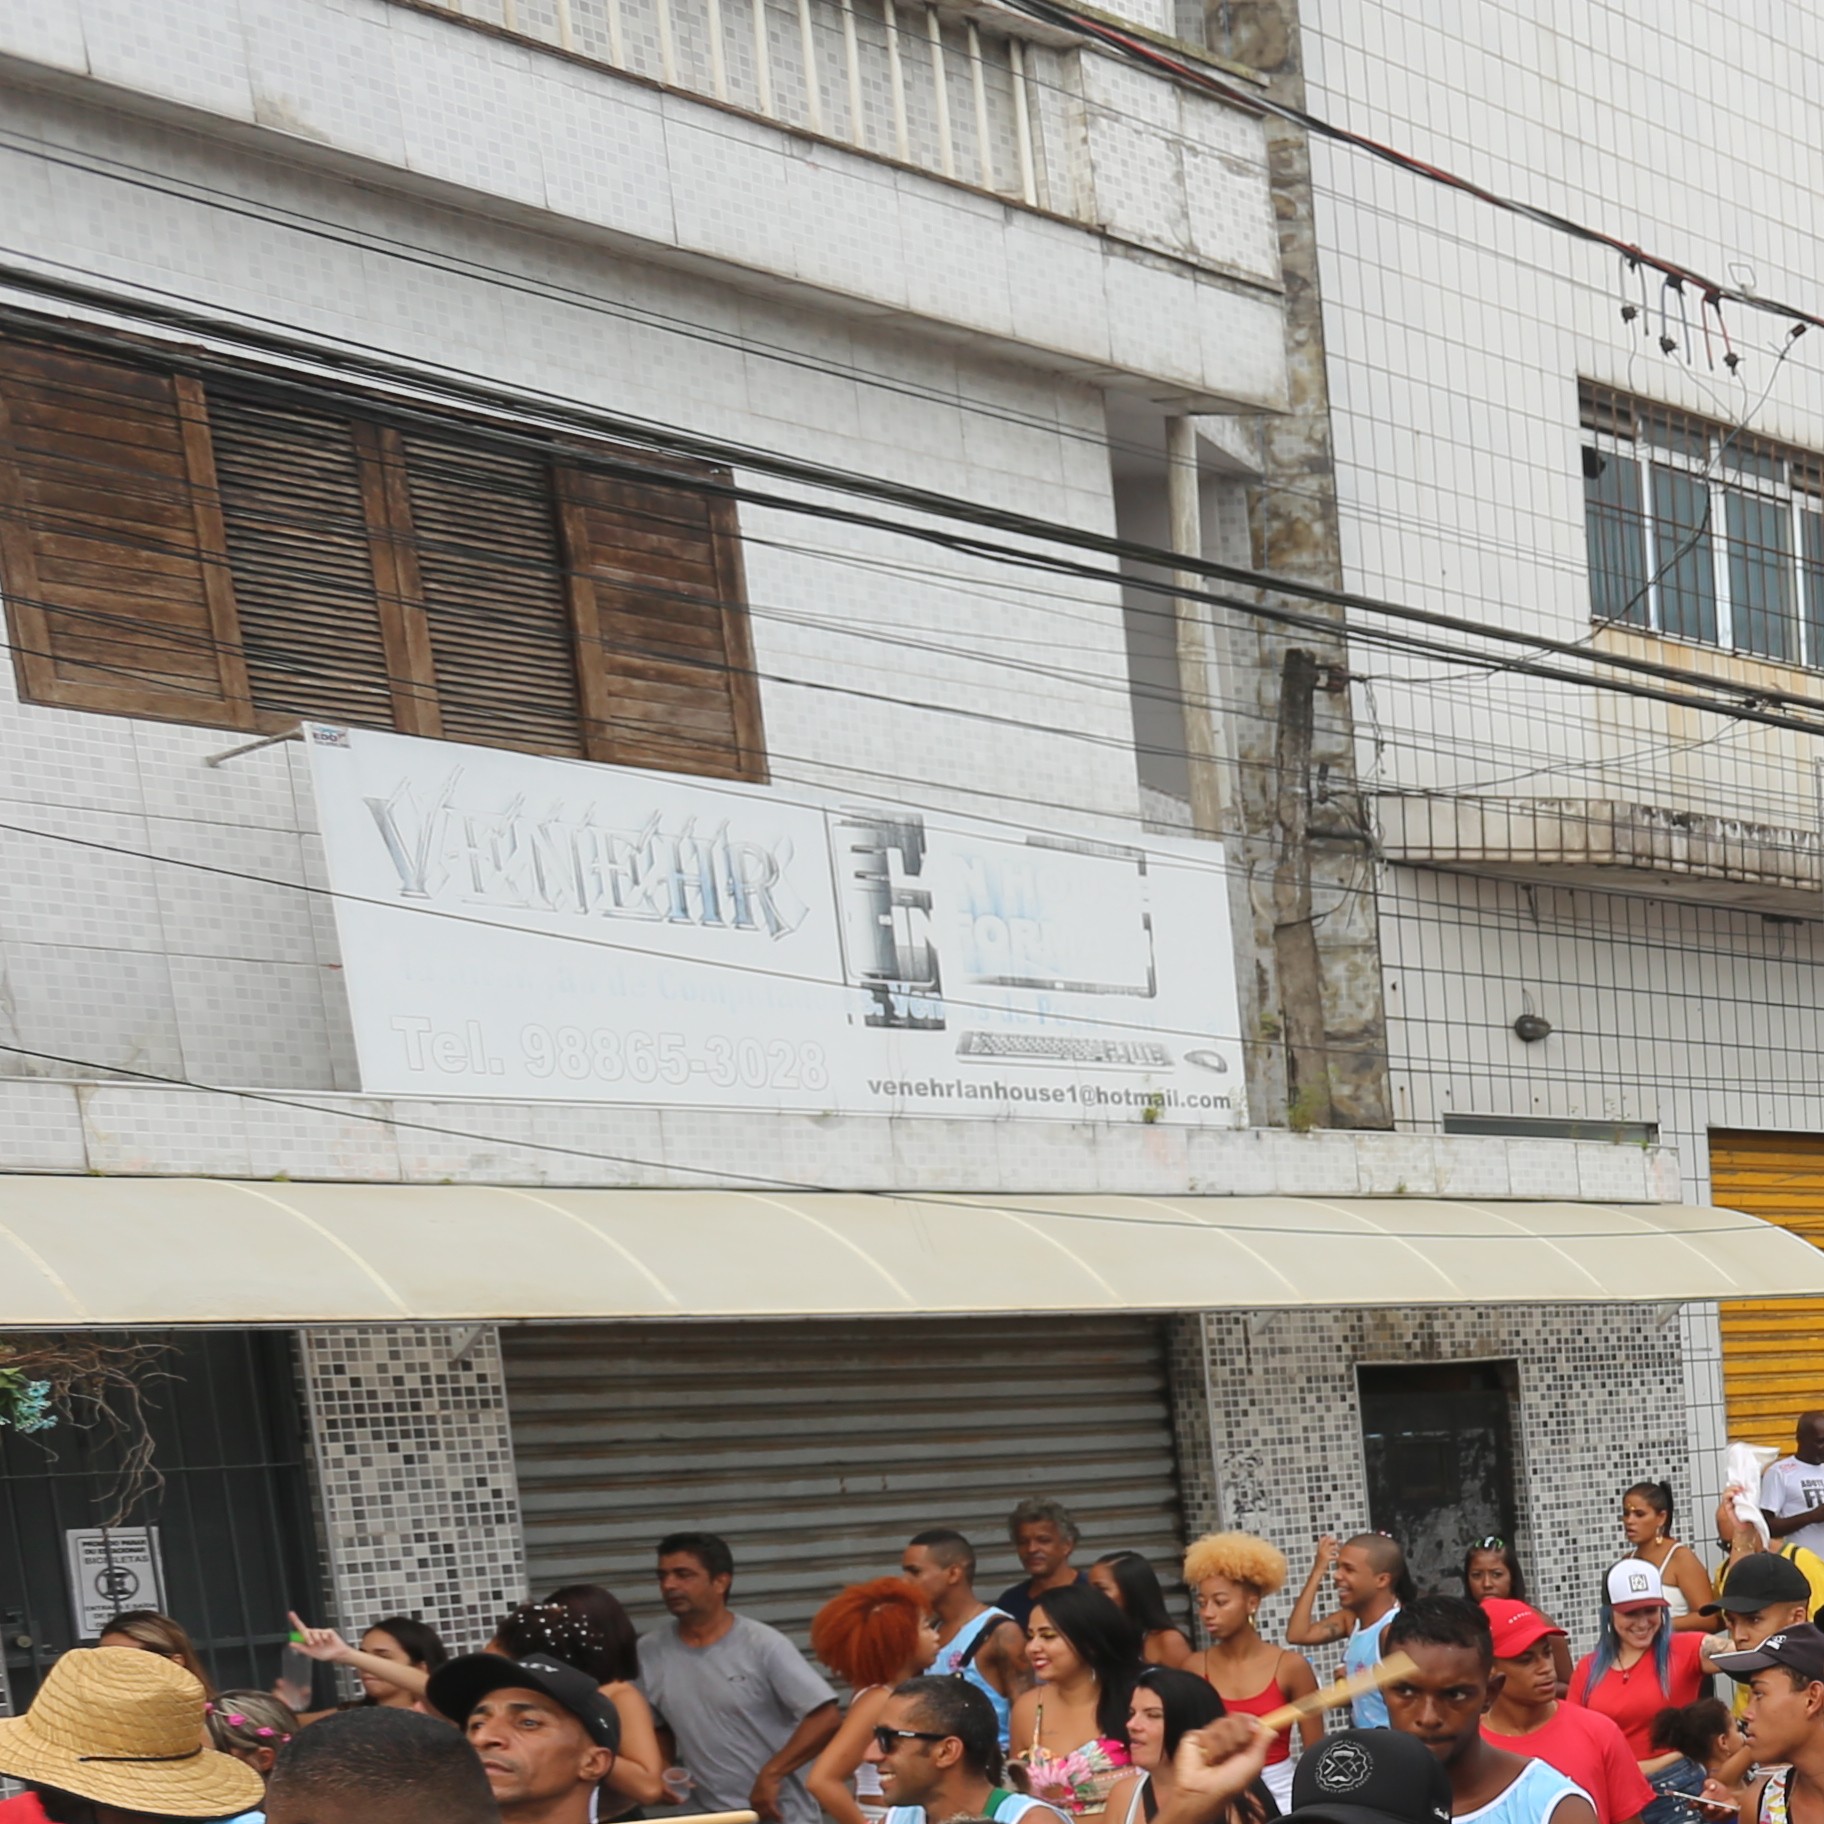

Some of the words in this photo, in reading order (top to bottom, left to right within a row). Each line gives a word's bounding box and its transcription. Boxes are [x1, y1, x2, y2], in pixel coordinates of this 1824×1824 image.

[390, 1014, 505, 1077] Tel.
[524, 1021, 830, 1092] 98865-3028
[868, 1075, 1232, 1110] venehrlanhouse1@hotmail.com
